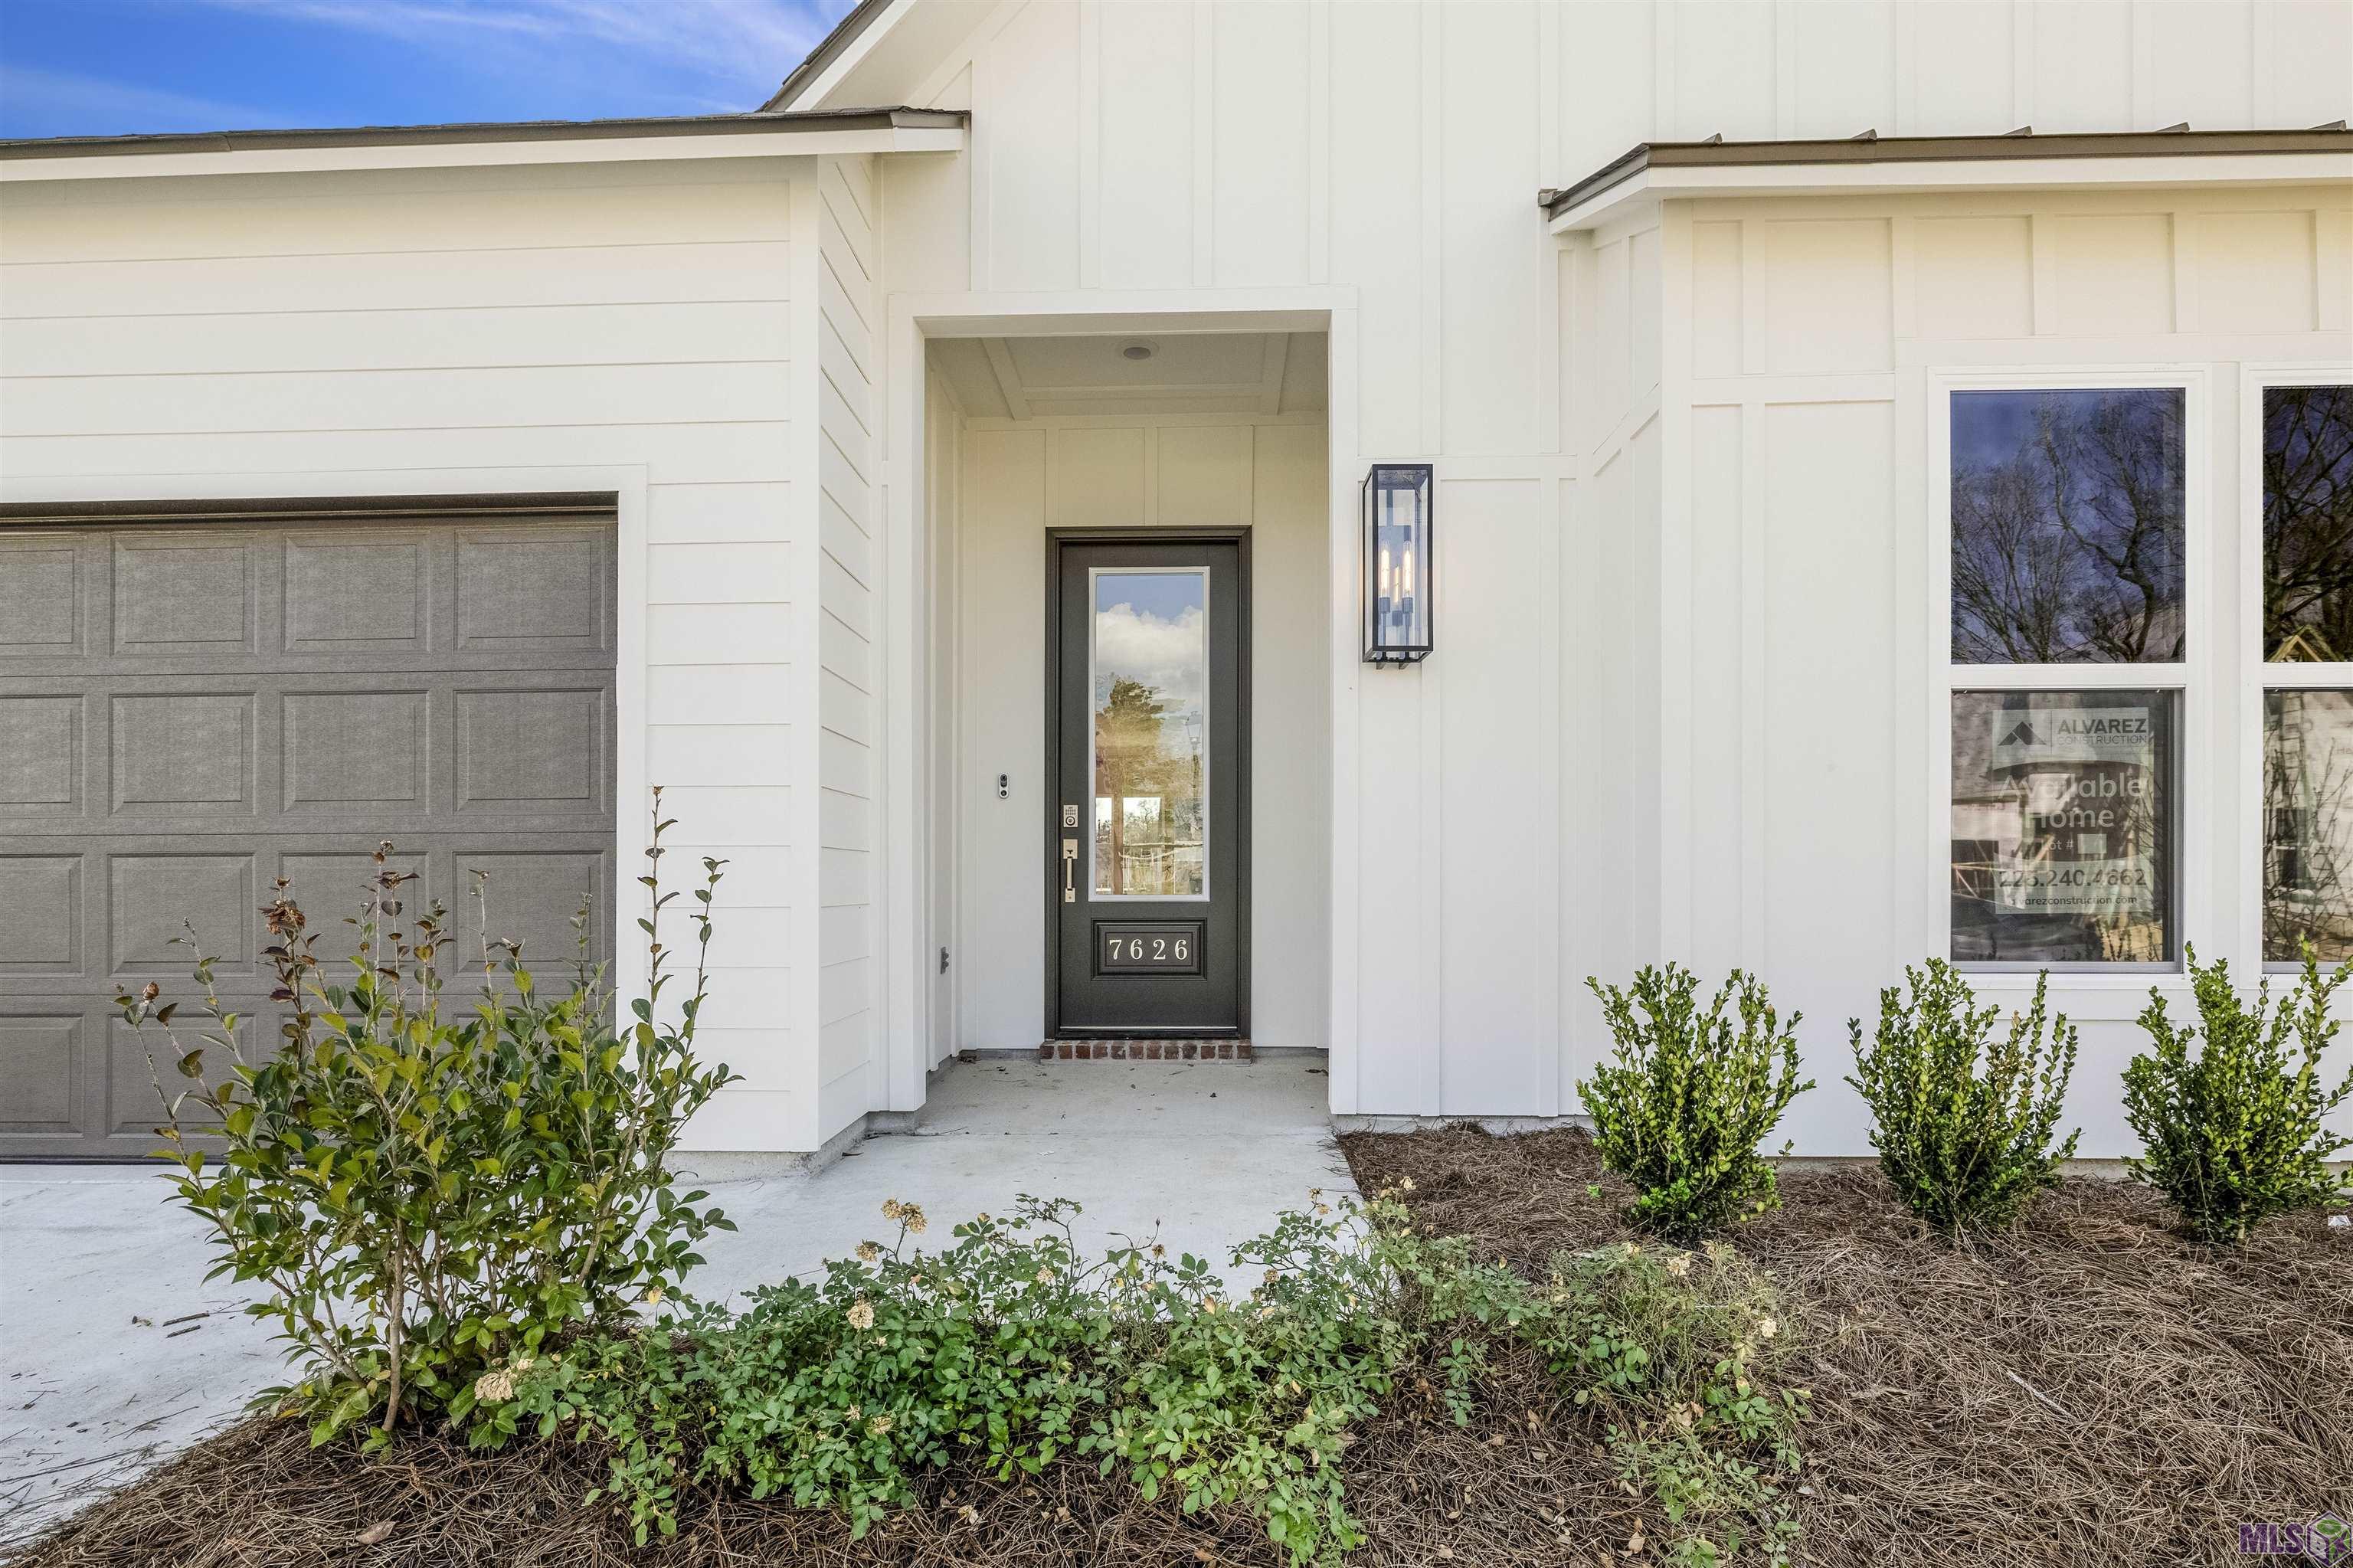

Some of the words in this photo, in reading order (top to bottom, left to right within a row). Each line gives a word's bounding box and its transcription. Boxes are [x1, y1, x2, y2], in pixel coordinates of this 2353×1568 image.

[2057, 718, 2147, 735] ALVAREZ
[2057, 735, 2147, 746] CONSTRUCTION
[2024, 805, 2115, 828] Home
[1109, 939, 1188, 960] 7626
